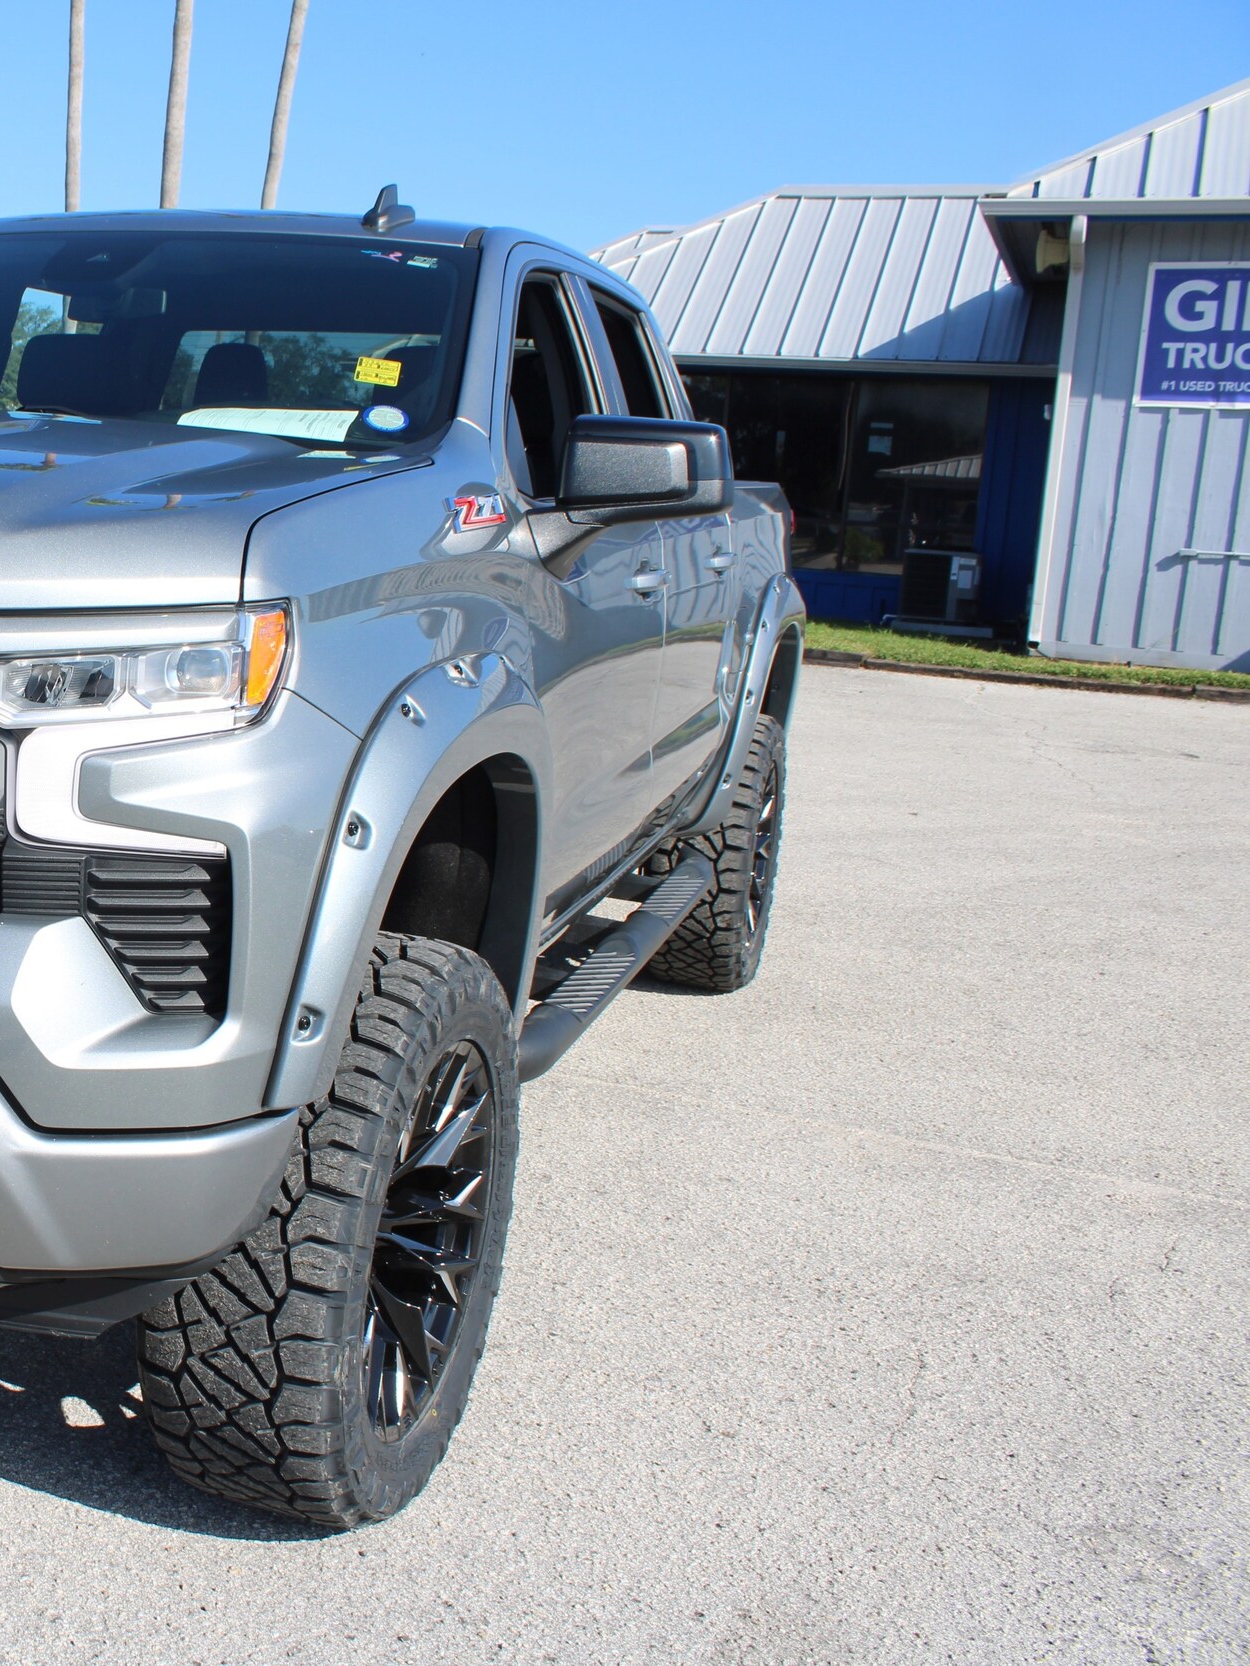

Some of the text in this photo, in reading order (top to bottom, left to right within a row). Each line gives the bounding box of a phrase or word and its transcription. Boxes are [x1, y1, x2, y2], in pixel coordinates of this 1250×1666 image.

[1164, 279, 1250, 332] GI
[1161, 380, 1175, 390] #1
[1180, 380, 1215, 391] USED
